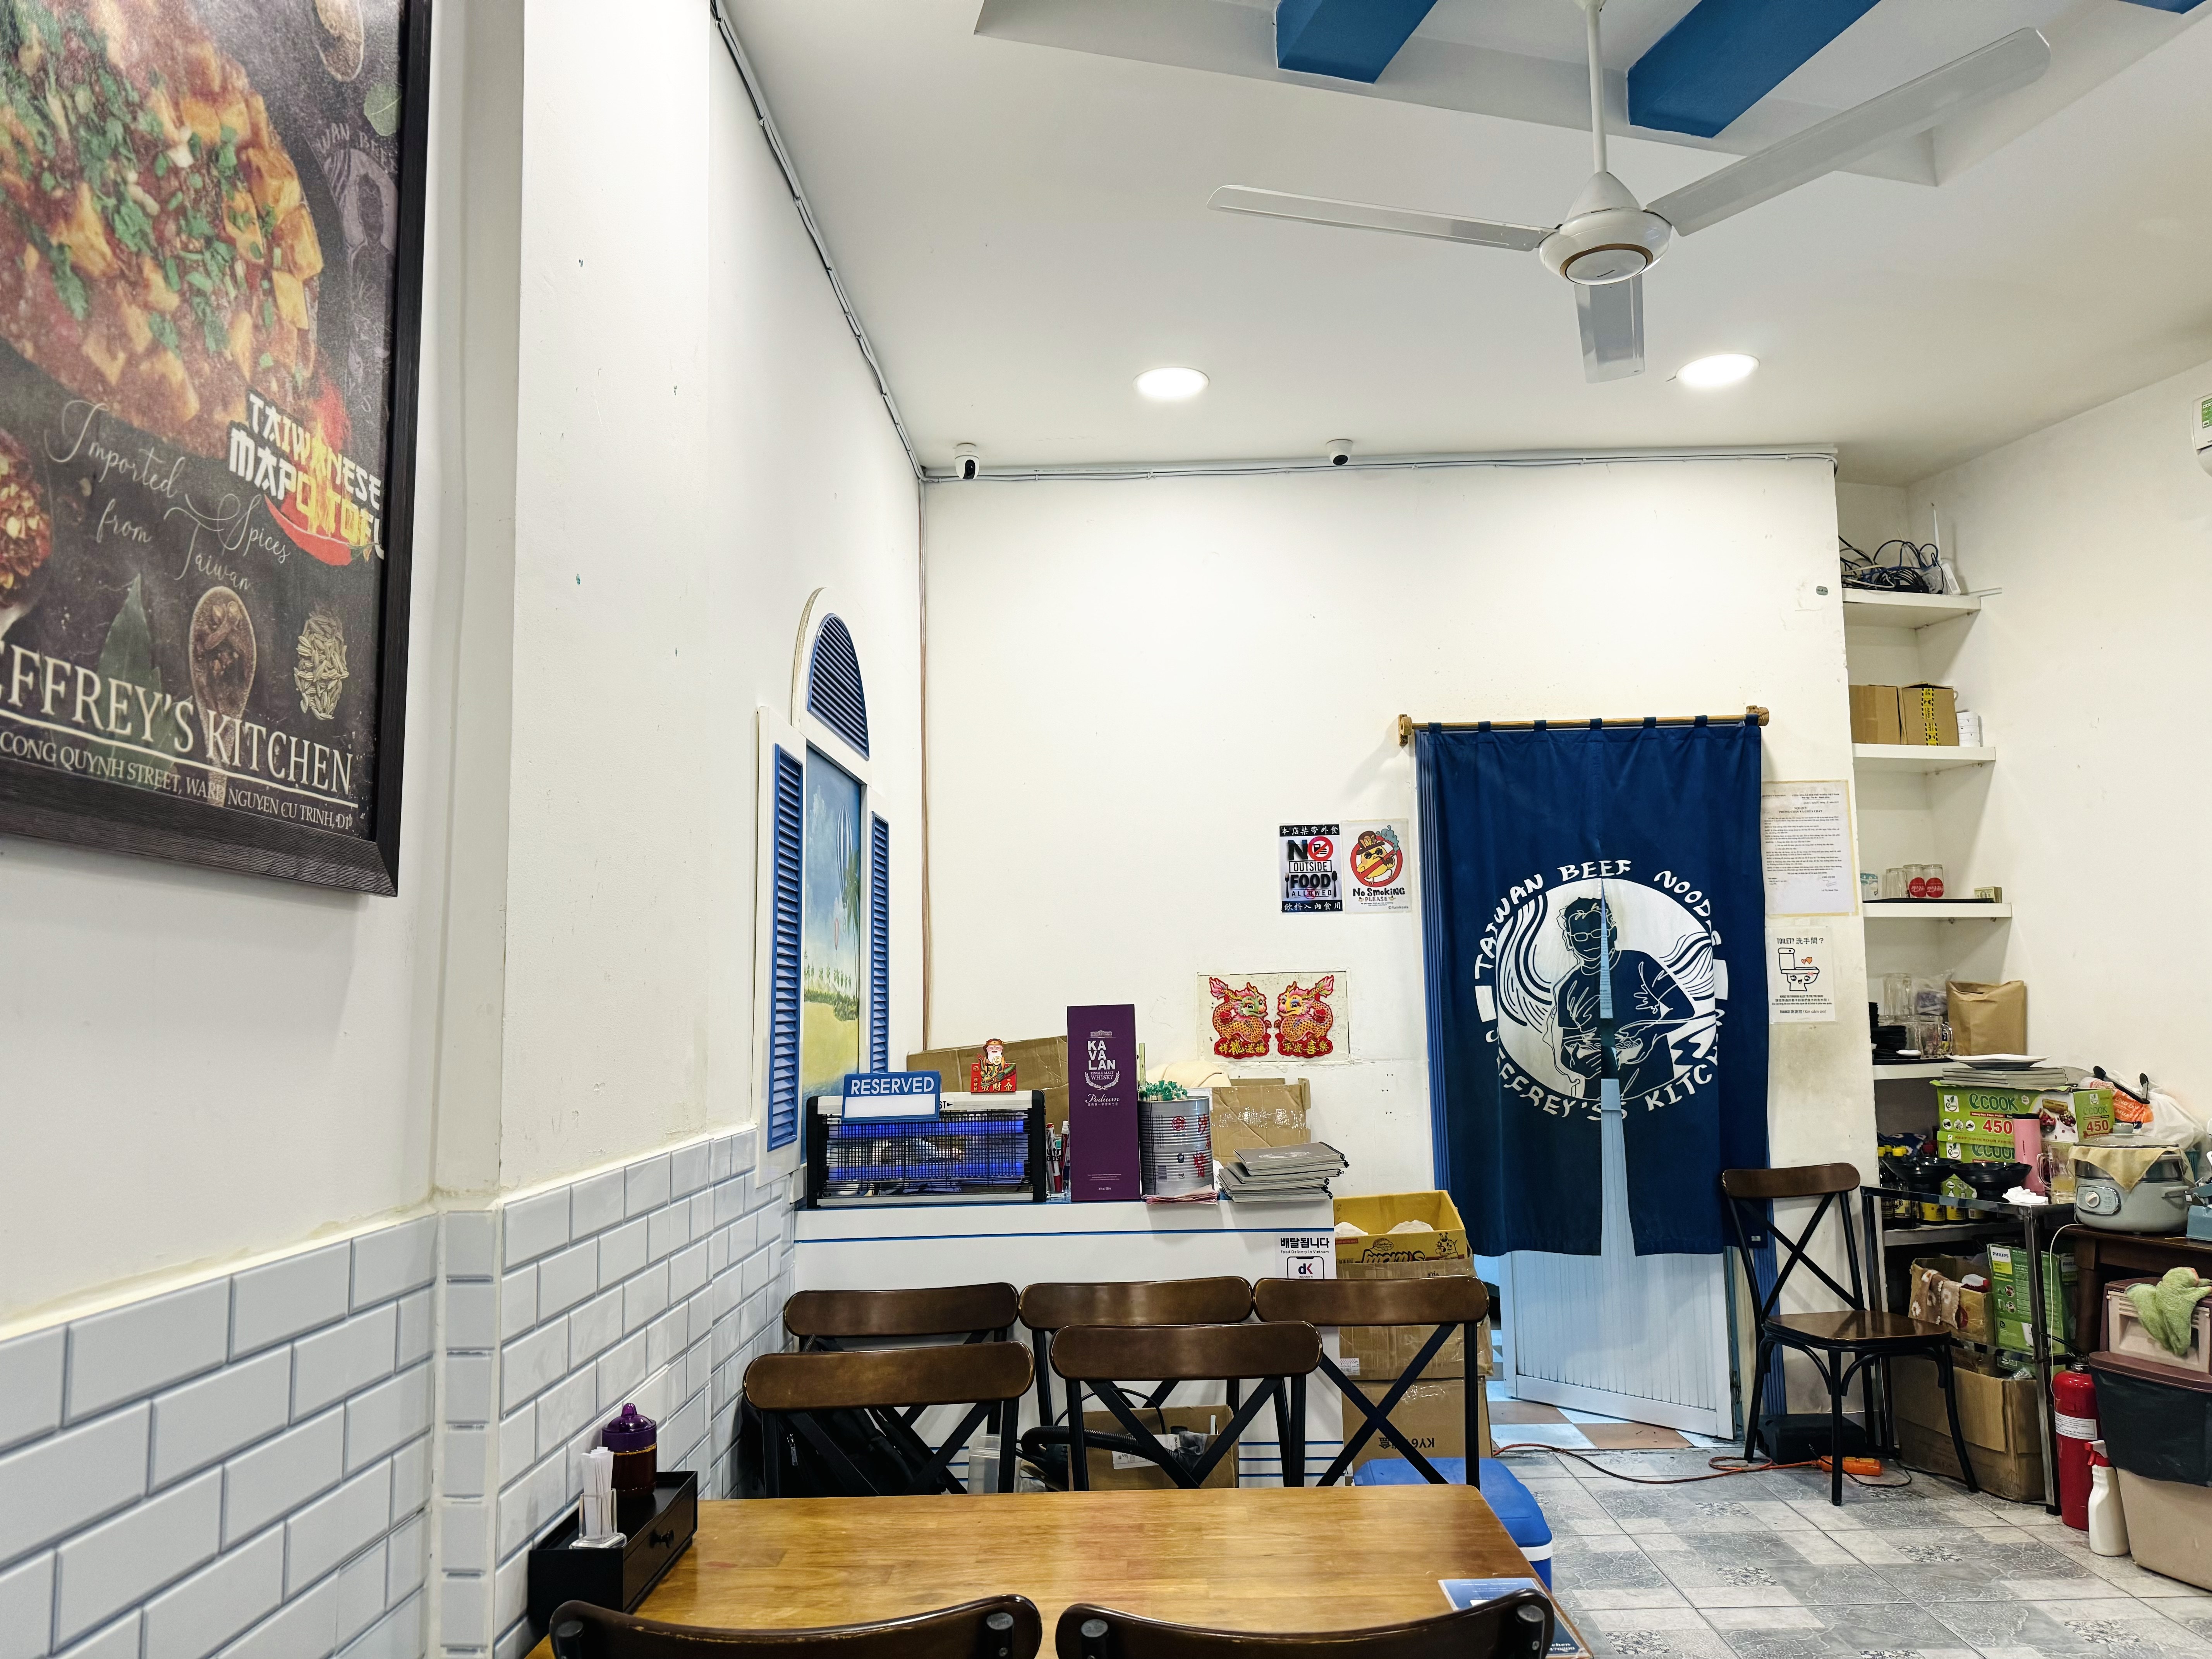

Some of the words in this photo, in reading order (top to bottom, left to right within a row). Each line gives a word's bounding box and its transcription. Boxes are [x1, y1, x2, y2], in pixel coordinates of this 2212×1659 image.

[249, 393, 381, 510] TAIWANESE
[45, 400, 185, 498] Imported
[185, 494, 291, 564] Spices
[97, 498, 151, 543] from
[163, 507, 251, 590] Taiwan
[0, 641, 193, 752] FFREY'S
[206, 709, 353, 795] KITCHEN
[1, 732, 57, 764] CONG
[60, 747, 125, 778] QUYNH
[127, 763, 183, 795] STREET,
[187, 778, 225, 800] WARD
[228, 788, 278, 814] NGUYEN
[281, 803, 297, 818] CU
[300, 805, 335, 828] TRINH,
[1293, 862, 1327, 872] OUTSIDE
[1290, 874, 1331, 888] FOOD
[1353, 888, 1365, 896] No
[1475, 874, 1543, 979] TAIWAN
[1557, 860, 1632, 881] BEEF
[1087, 1040, 1106, 1051] KA
[1088, 1050, 1107, 1060] VA
[1088, 1060, 1116, 1070] LAN
[851, 1077, 934, 1095] RESERVED
[1085, 1094, 1120, 1103] Podium
[1983, 1120, 2013, 1134] 450
[2087, 1120, 2109, 1132] 450
[1280, 1237, 1330, 1248] 배달됩니다
